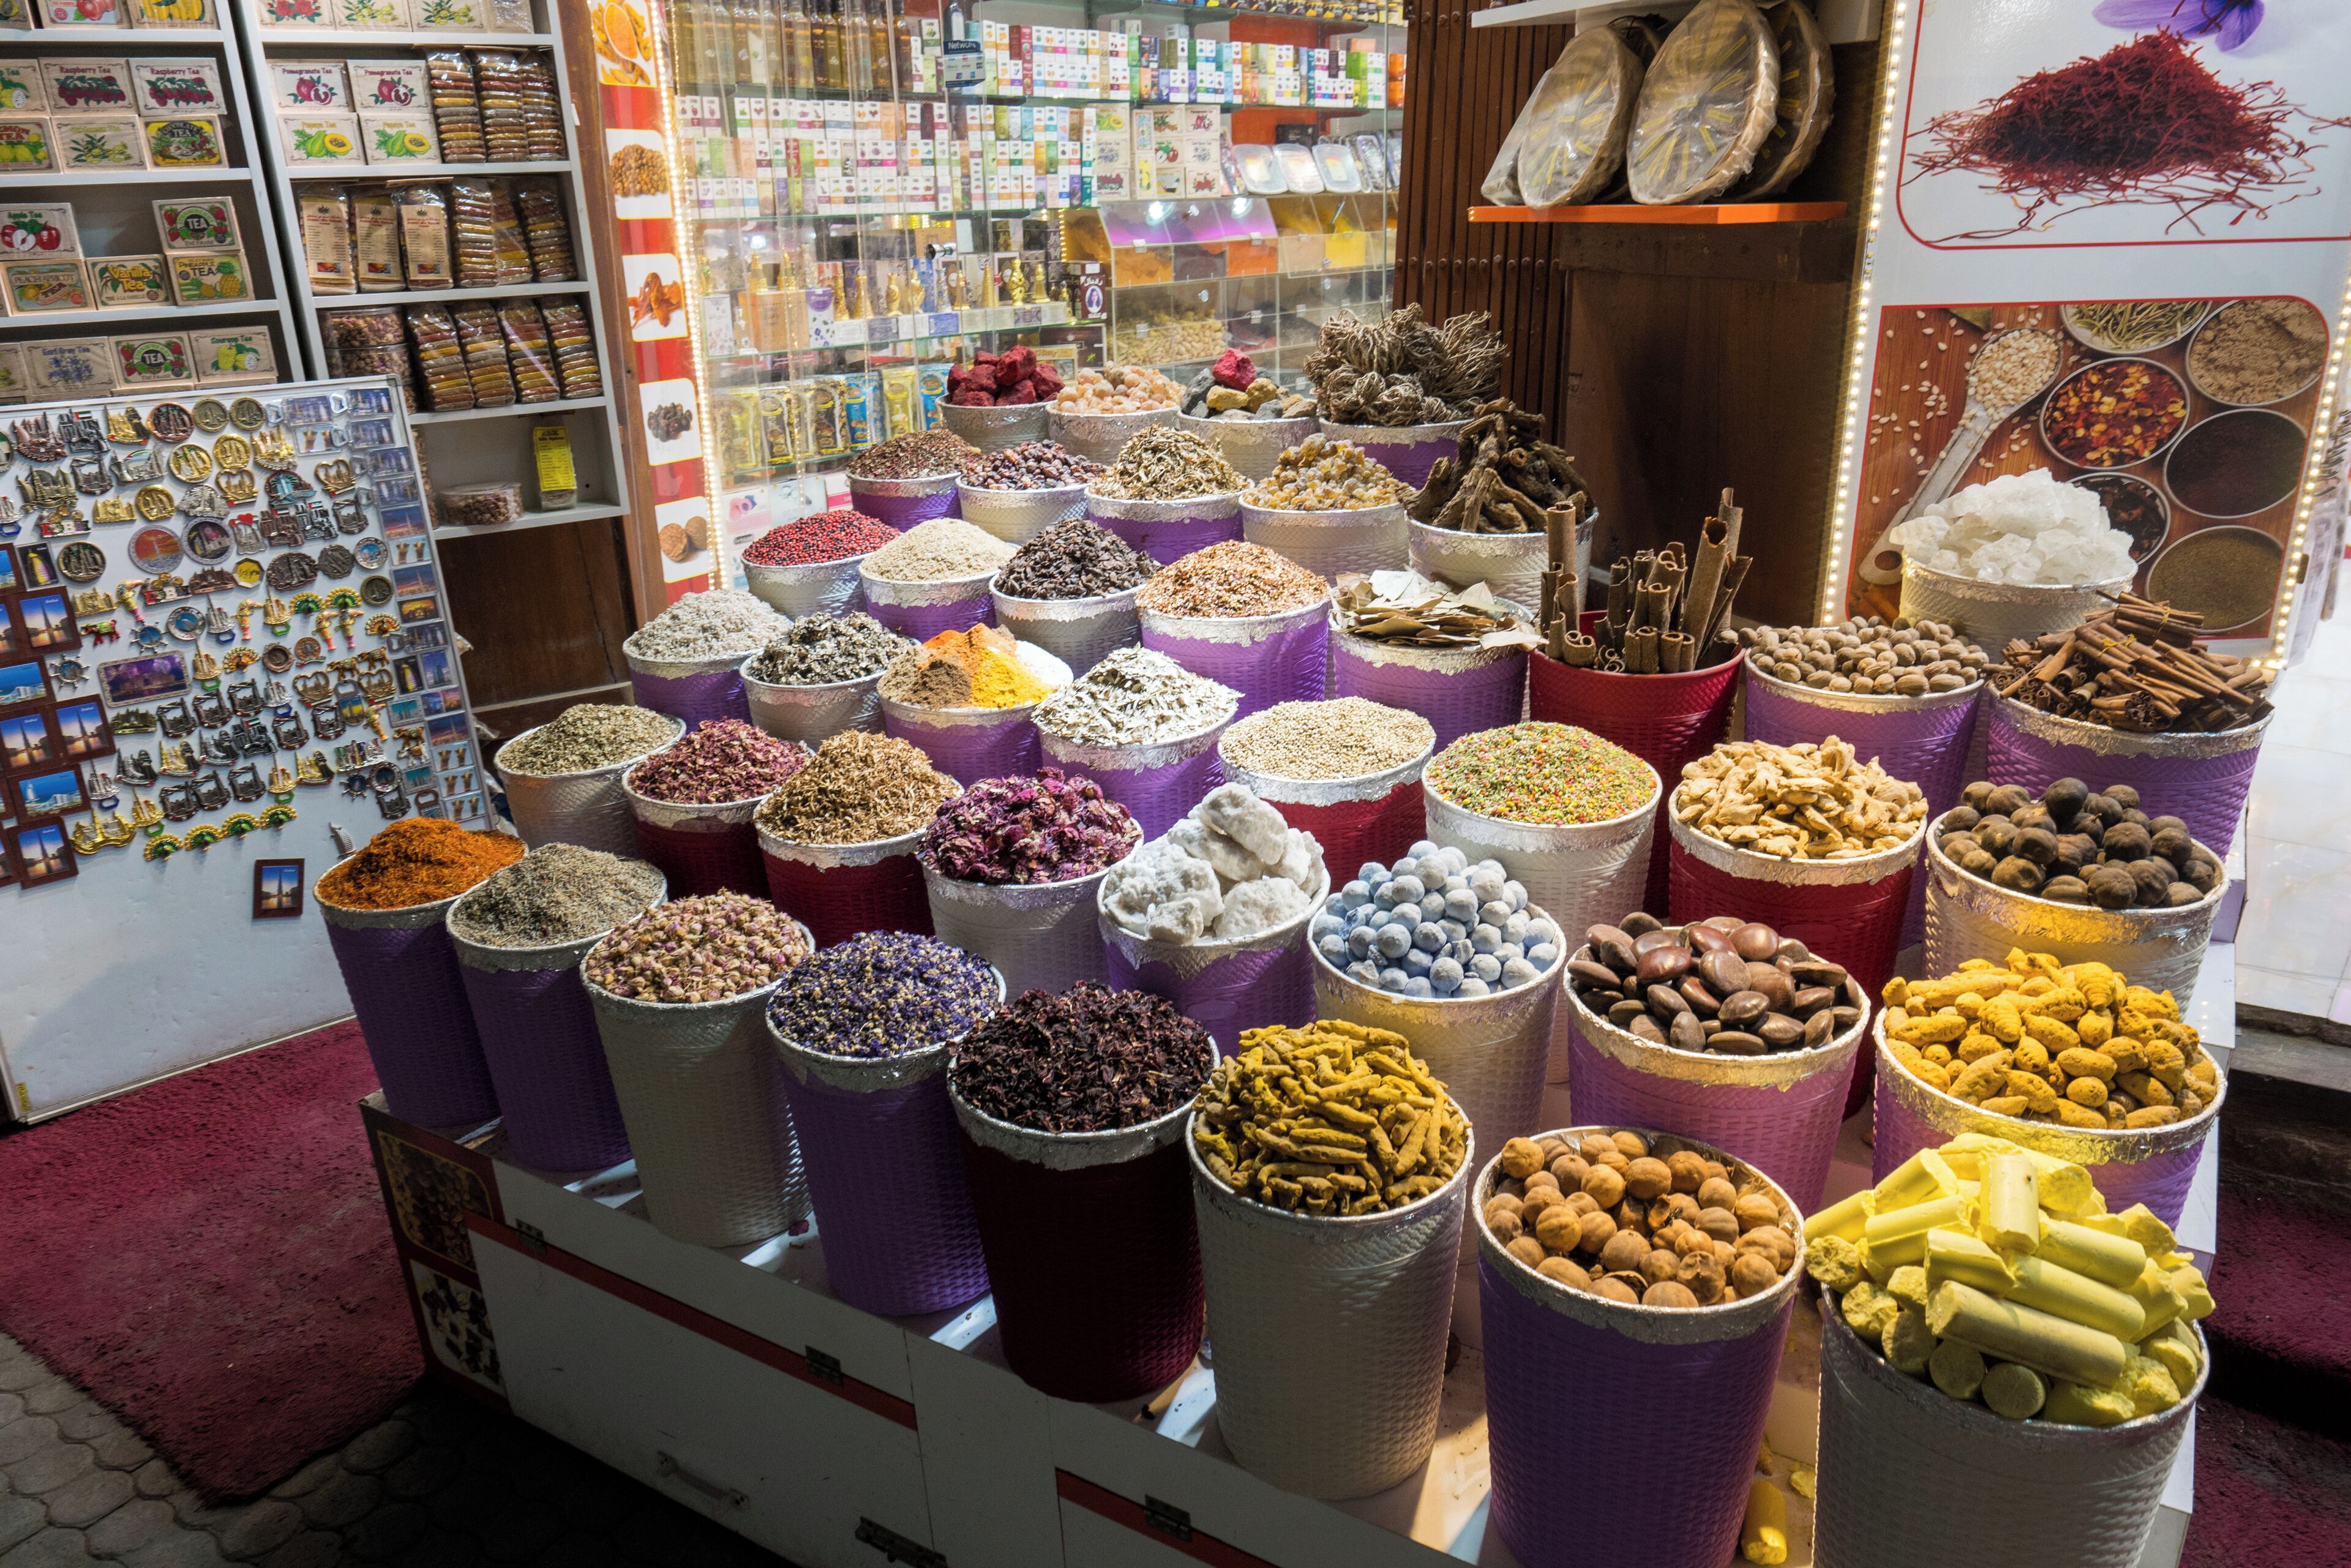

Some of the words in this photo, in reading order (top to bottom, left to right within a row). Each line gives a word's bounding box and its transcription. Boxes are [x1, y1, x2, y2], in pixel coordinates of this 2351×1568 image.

[59, 66, 96, 74] Raspberry
[172, 129, 192, 137] TEA
[186, 218, 208, 230] TEA
[108, 264, 152, 279] Vanilla
[190, 267, 217, 276] TEA
[120, 278, 146, 293] Tea
[143, 353, 165, 364] TEA
